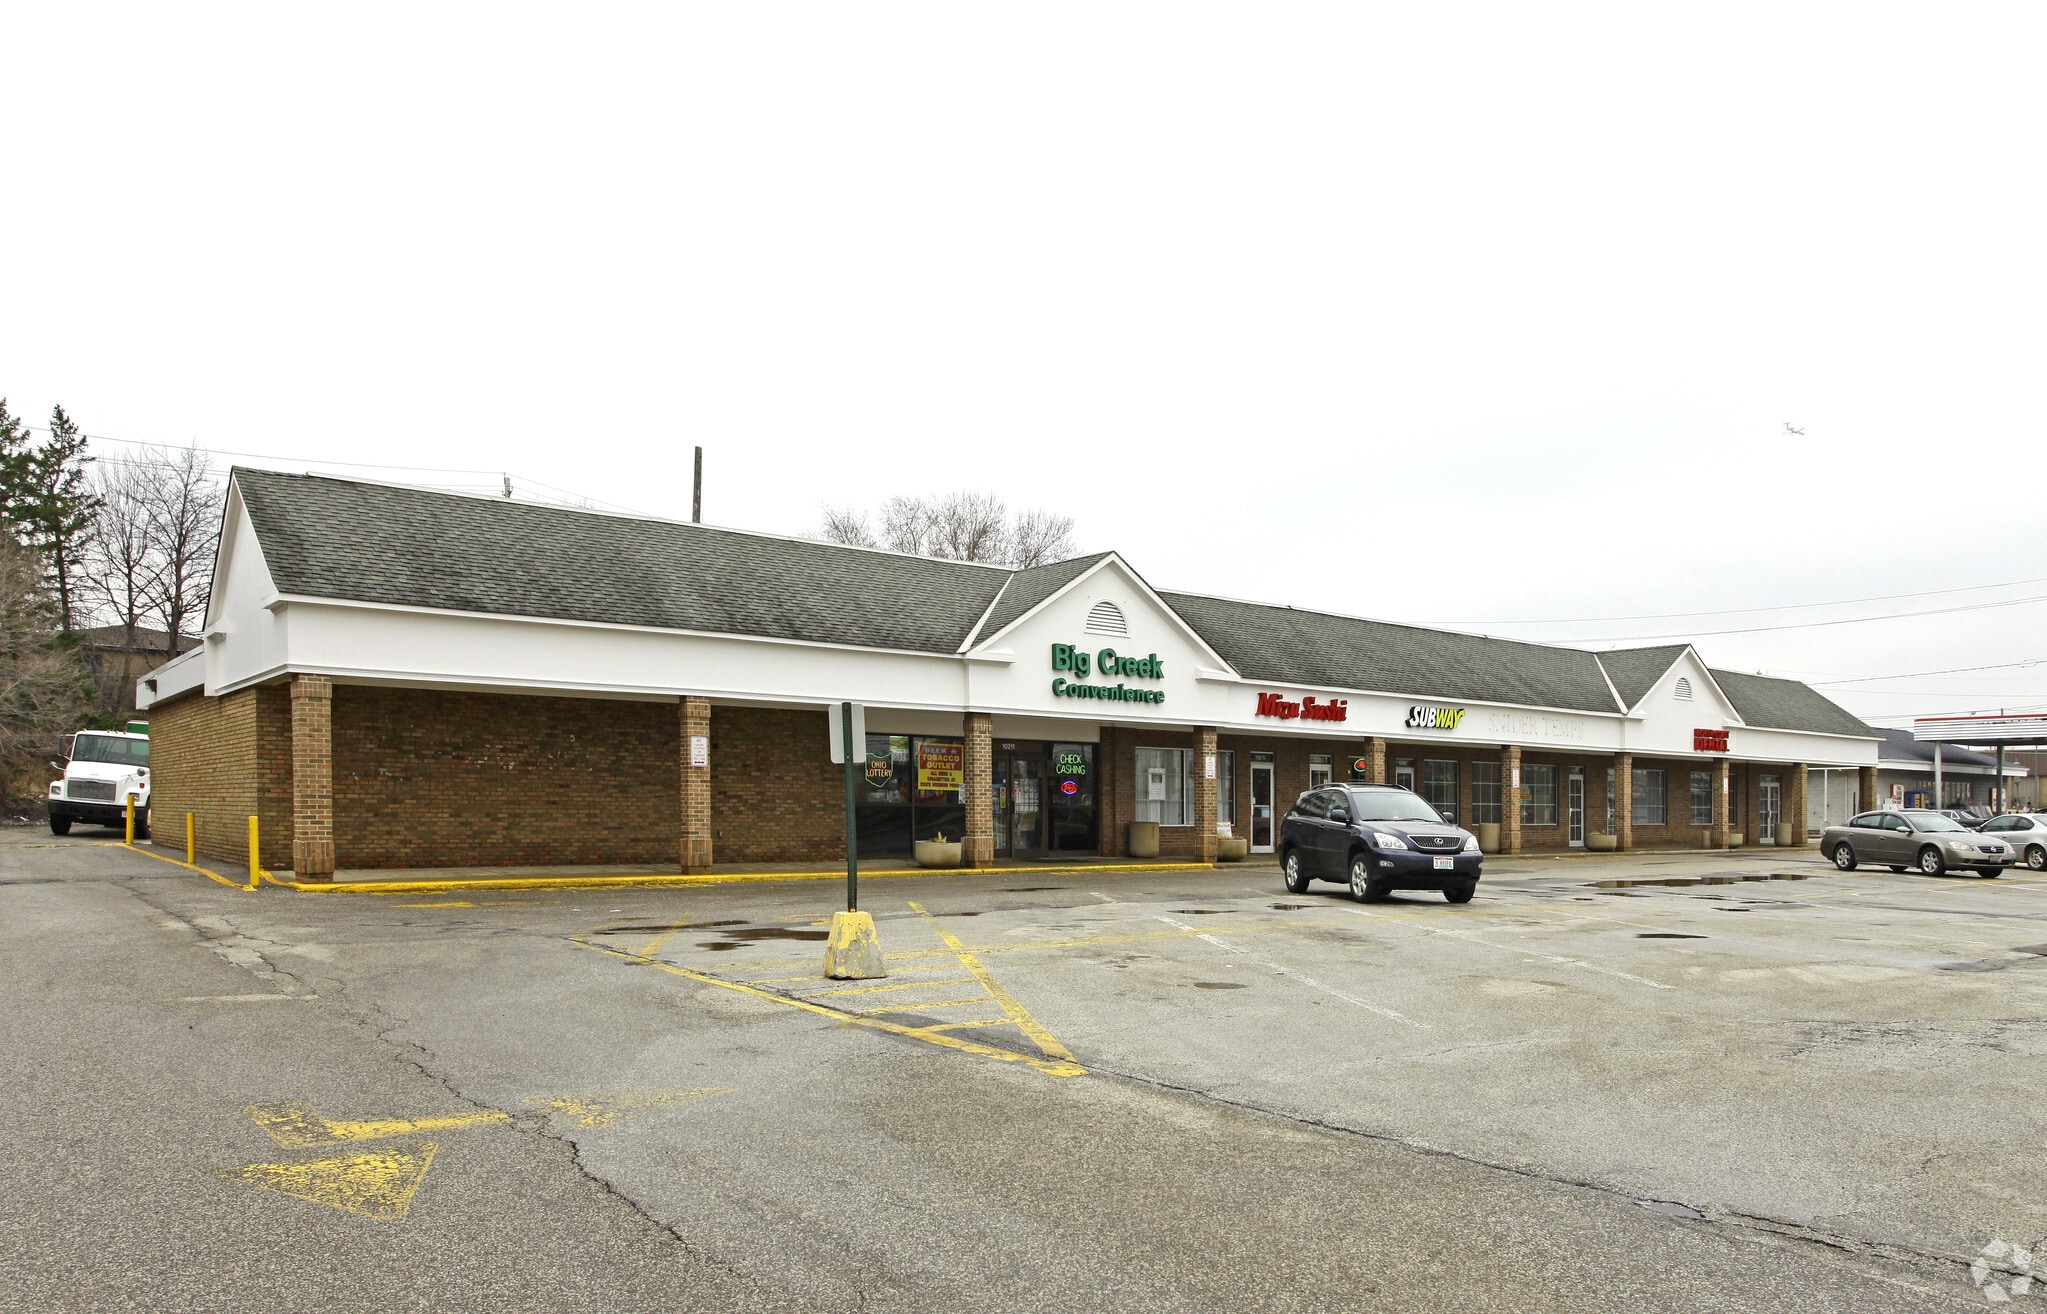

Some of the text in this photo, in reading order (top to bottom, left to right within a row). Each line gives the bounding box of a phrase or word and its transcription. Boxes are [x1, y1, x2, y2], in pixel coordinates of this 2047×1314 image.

[1052, 643, 1164, 679] Big Creek
[1052, 678, 1165, 704] Convenience
[1255, 692, 1348, 722] Mizu Sushi
[1405, 706, 1466, 729] SUBWAY
[871, 760, 887, 769] OHIO
[1060, 754, 1082, 764] CHECK
[866, 768, 892, 778] LOTTERY
[1056, 763, 1086, 775] CASHING
